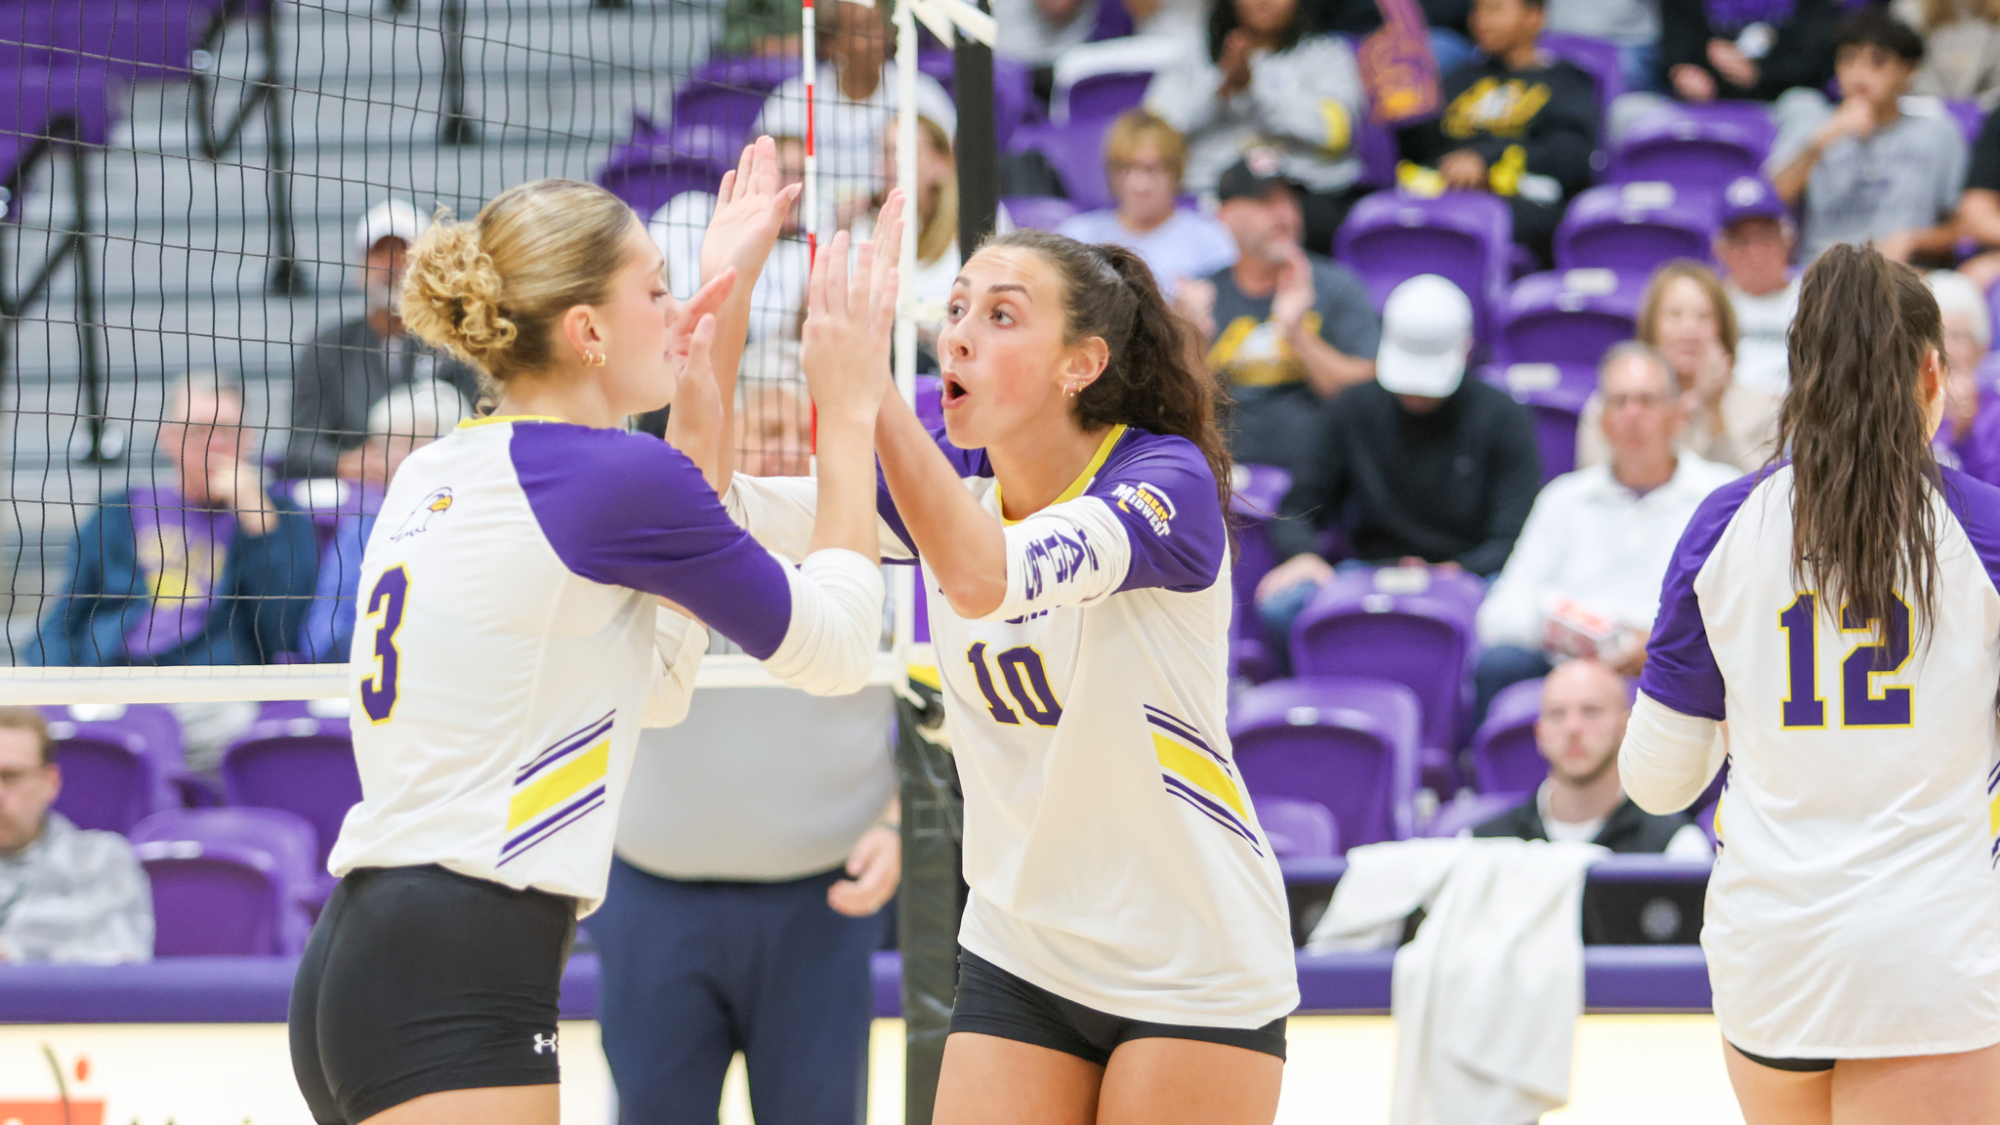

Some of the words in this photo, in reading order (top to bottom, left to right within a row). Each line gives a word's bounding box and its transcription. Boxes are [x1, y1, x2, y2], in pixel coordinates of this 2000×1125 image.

[1111, 483, 1171, 537] MIDWEST
[1136, 488, 1169, 522] GREAT
[360, 561, 413, 726] 3
[966, 639, 1064, 729] 10
[1777, 586, 1915, 731] 12
